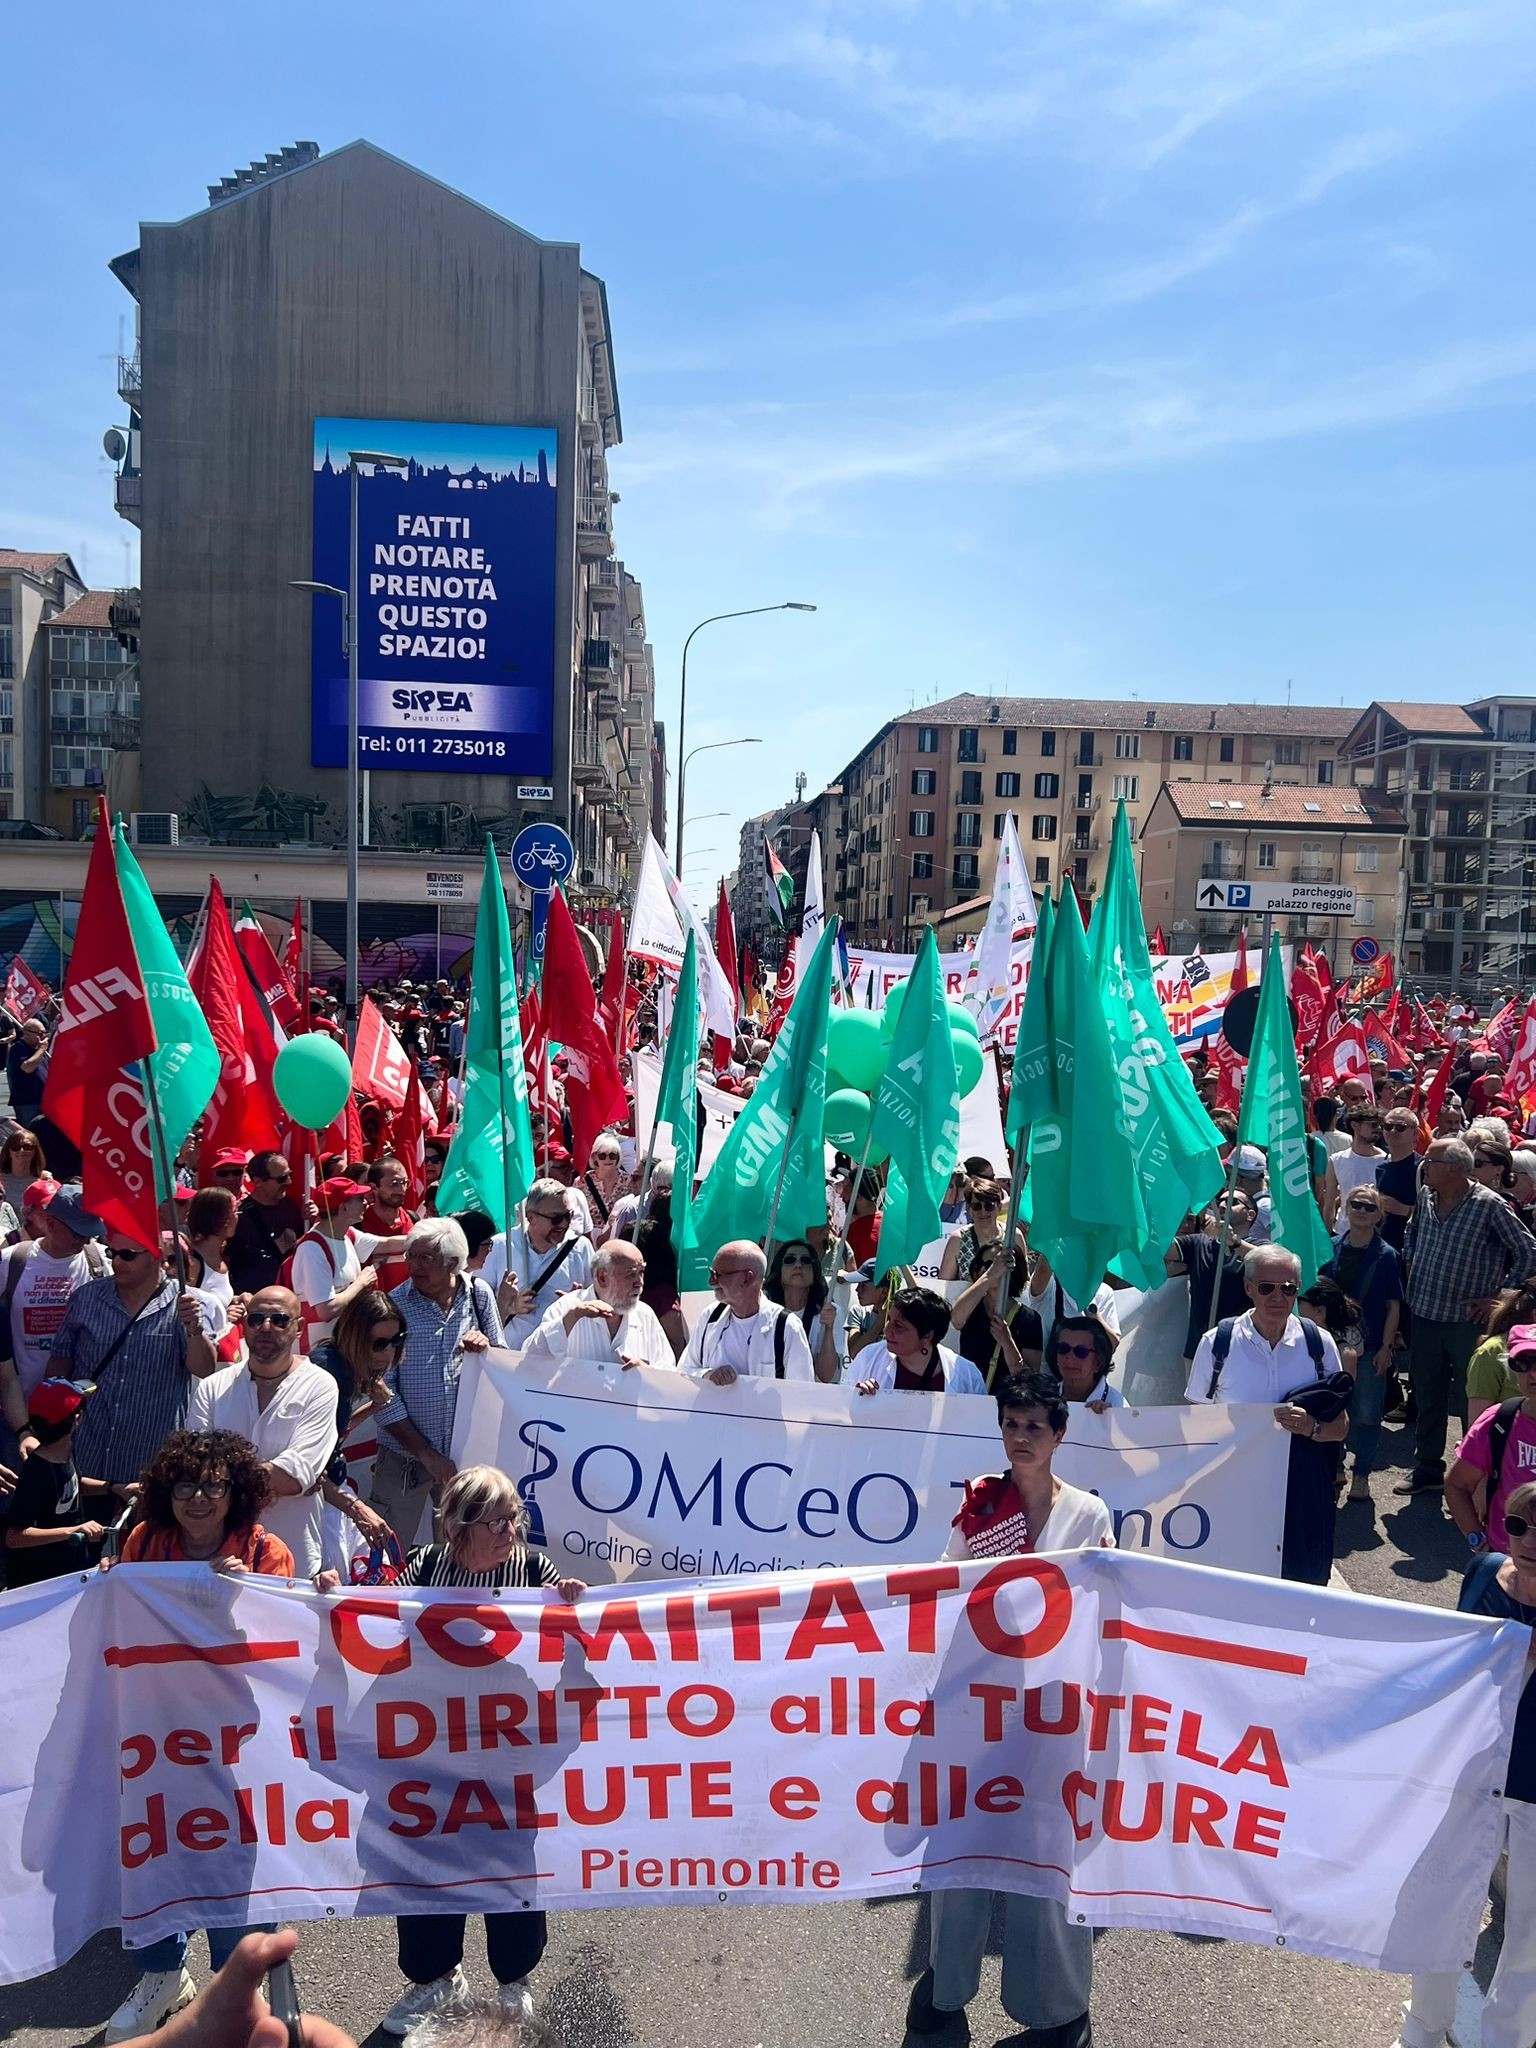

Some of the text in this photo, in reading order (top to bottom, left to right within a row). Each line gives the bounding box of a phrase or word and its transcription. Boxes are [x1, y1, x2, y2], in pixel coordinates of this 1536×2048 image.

[397, 514, 470, 539] FATTI
[374, 544, 492, 574] NOTARE,
[369, 573, 498, 601] PRENOTA
[378, 603, 487, 631] QUESTO
[378, 634, 486, 660] SPAZIO!
[359, 735, 506, 757] Tel: 011 2735018
[438, 873, 464, 882] VENDESI
[1267, 898, 1352, 914] palazzo regione
[1292, 887, 1353, 898] parcheggio
[640, 937, 650, 946] La
[571, 1443, 919, 1546] OMCeO
[562, 1530, 653, 1567] Ordine
[661, 1545, 702, 1575] dei
[330, 1557, 1073, 1676] COMITATO
[120, 1676, 1290, 1795] per il DIRITTO alla TUTELA
[120, 1761, 1287, 1869] della SALUTE e alle CURE
[580, 1849, 841, 1889] Piemonte
